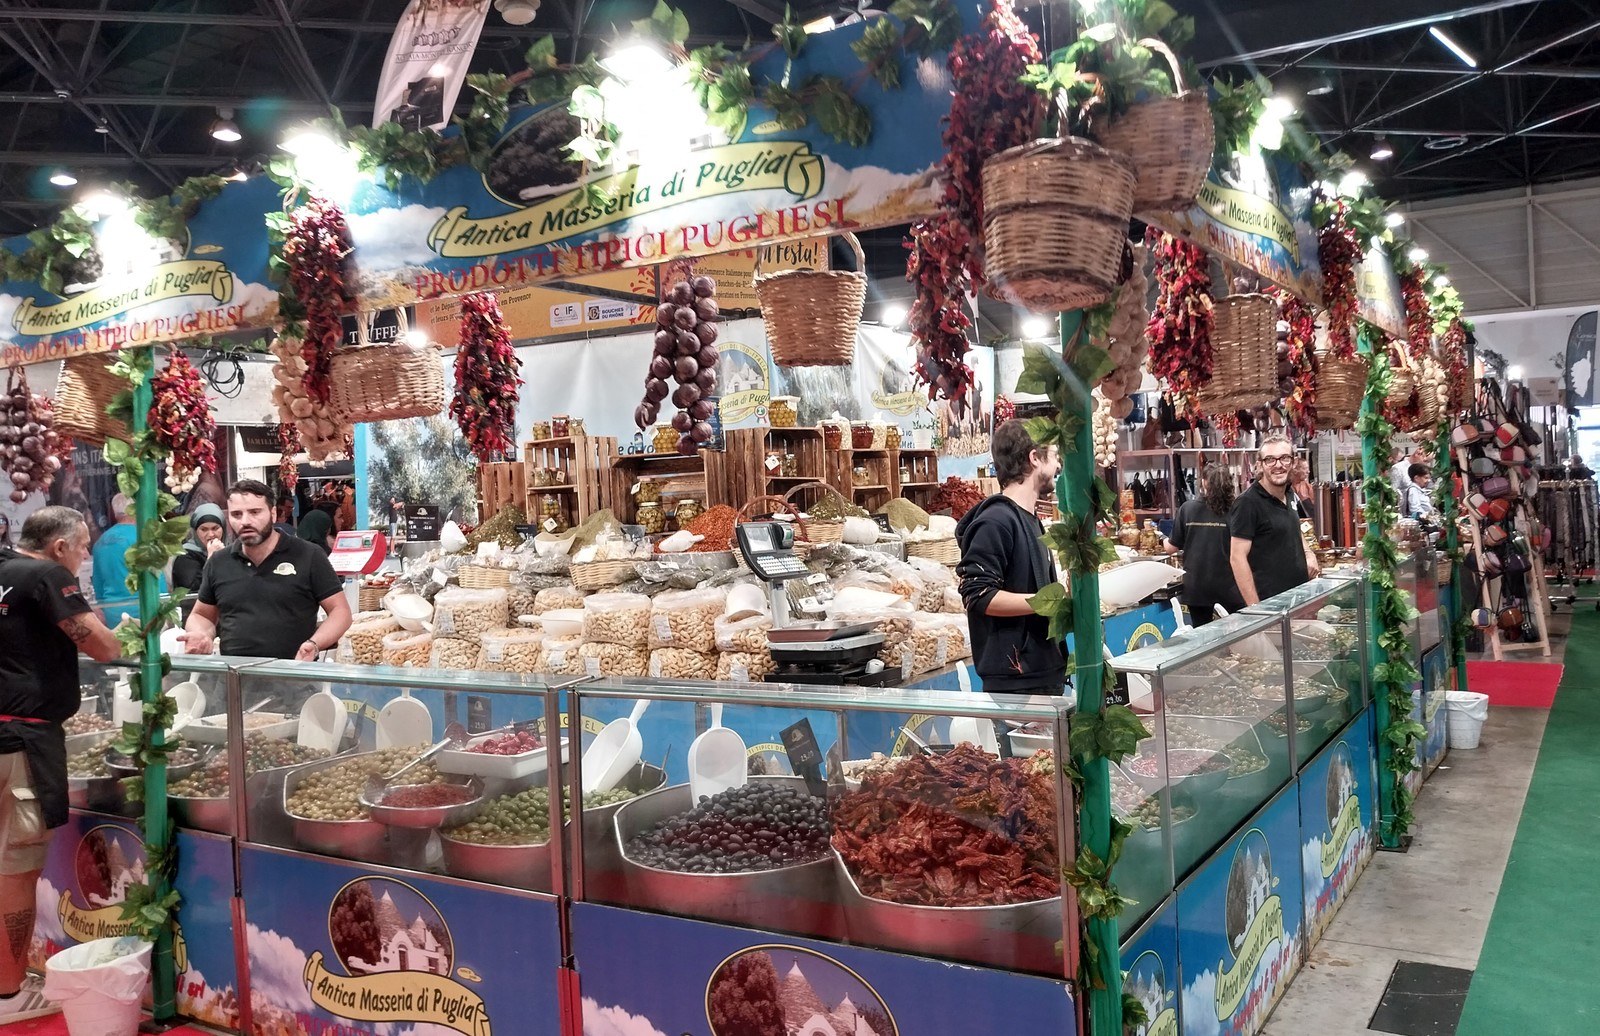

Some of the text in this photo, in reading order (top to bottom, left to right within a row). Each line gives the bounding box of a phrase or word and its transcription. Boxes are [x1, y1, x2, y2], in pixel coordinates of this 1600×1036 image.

[453, 149, 788, 247] Antica Masseria di Puglia
[1228, 199, 1261, 226] Masseria
[1263, 212, 1270, 230] di
[1271, 215, 1291, 242] Puglia
[415, 196, 852, 299] PRODOTTI TIPICI PUGLIESI
[27, 266, 212, 328] Antica Masseria di Puglia
[508, 293, 532, 304] Provence
[3, 331, 88, 364] PRODOTTI
[155, 304, 245, 338] PUGLIESI
[740, 394, 748, 404] di
[67, 911, 94, 936] Antica
[316, 976, 475, 1024] Antica Masseria di Puglia
